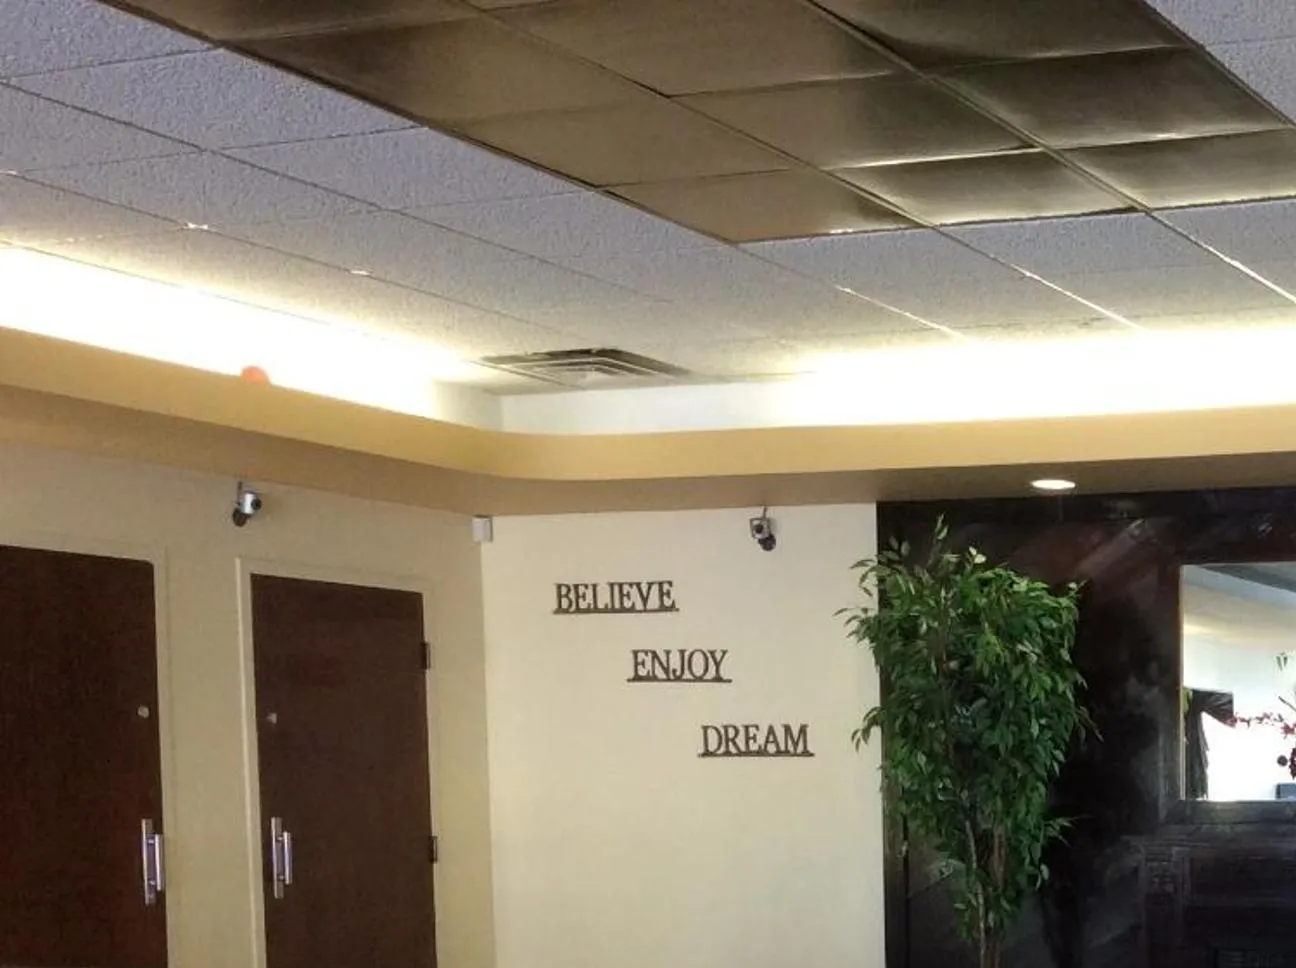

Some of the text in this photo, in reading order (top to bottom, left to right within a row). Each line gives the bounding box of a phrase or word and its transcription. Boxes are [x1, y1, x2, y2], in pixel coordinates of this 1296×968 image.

[554, 581, 678, 614] BELIEVE
[628, 649, 731, 682] ENJOY
[699, 724, 813, 757] DREAM
